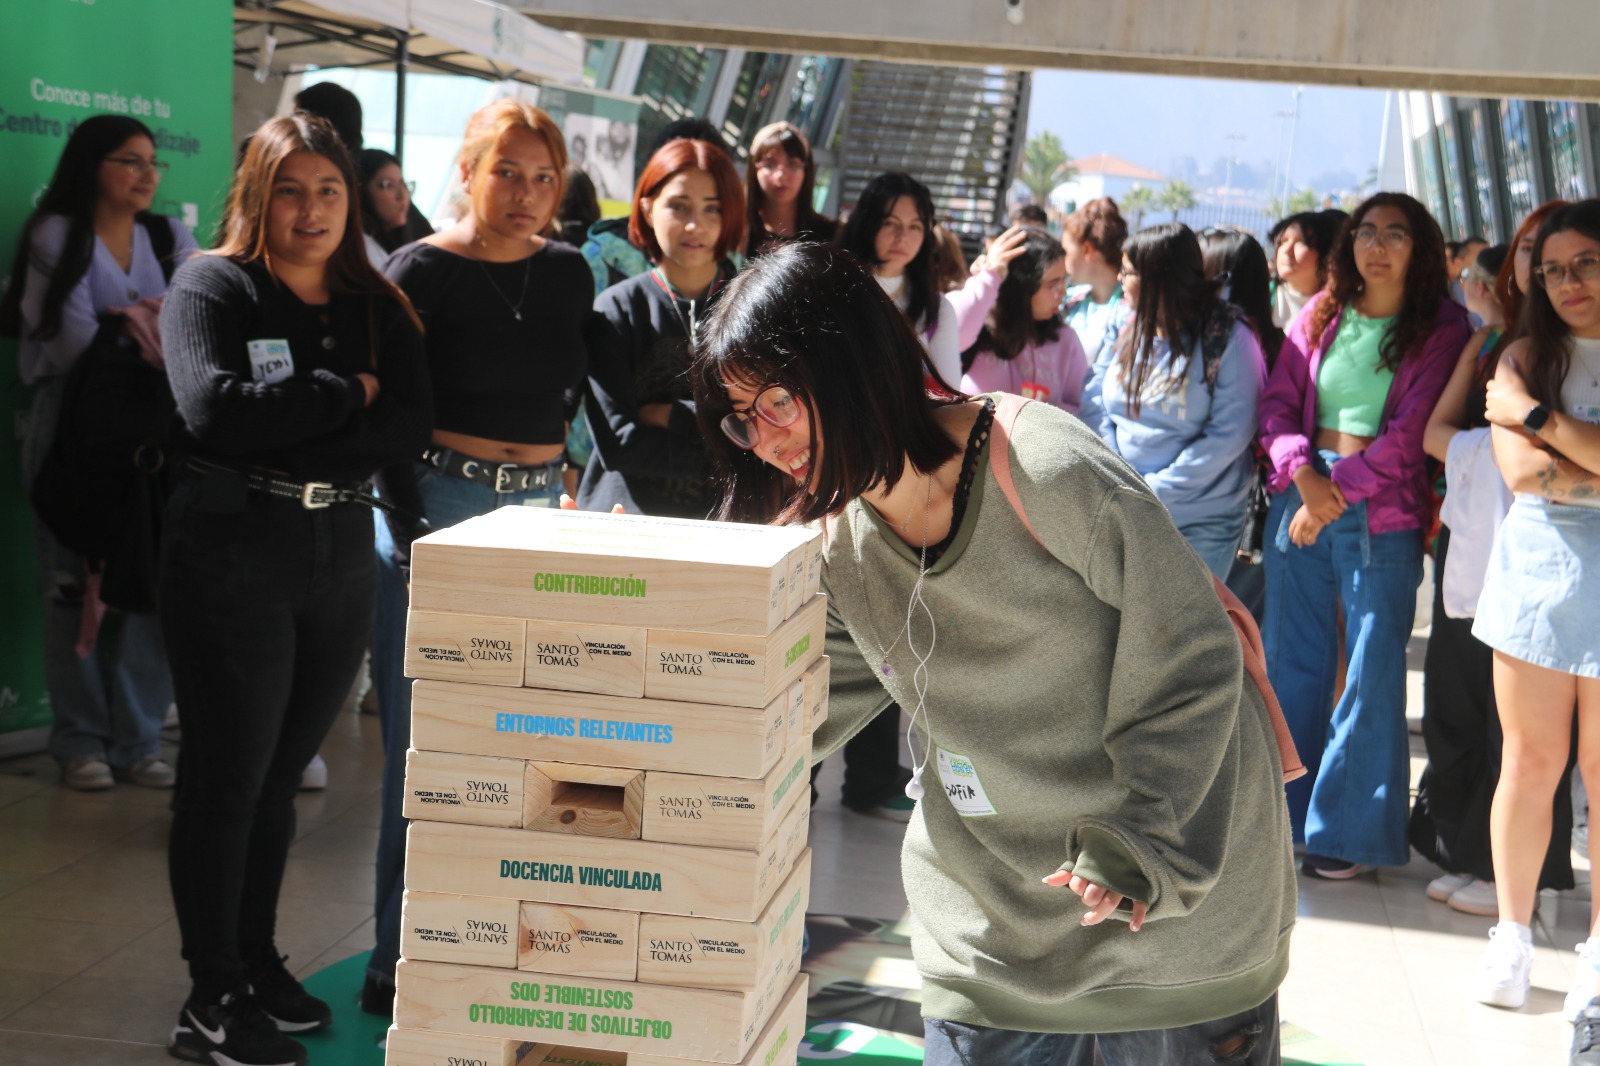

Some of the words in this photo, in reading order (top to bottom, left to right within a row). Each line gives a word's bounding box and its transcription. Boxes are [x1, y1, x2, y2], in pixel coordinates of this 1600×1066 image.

[31, 77, 91, 108] Conoce
[93, 90, 129, 113] más
[131, 93, 152, 117] de
[154, 97, 171, 119] tu
[534, 572, 646, 598] CONTRIBUCIÓN
[537, 642, 579, 656] SANTO
[585, 641, 625, 649] VINCULACIÓN
[470, 650, 513, 662] SANTO
[537, 654, 579, 667] TOMÁS
[660, 651, 702, 664] SANTO
[708, 650, 749, 659] VINCULACIÓN
[660, 662, 702, 676] TOMÁS
[735, 658, 755, 666] MEDIO
[496, 712, 575, 737] ENTORNOS
[579, 718, 673, 744] RELEVANTES
[466, 791, 509, 804] SANTO
[660, 796, 702, 808] SANTO
[707, 794, 749, 803] VINCULACIÓN
[660, 806, 702, 820] TOMÁS
[500, 859, 573, 884] DOCENCIA
[579, 866, 662, 892] VINCULADA
[466, 931, 508, 945] SANTO
[528, 929, 571, 943] SANTO
[576, 929, 617, 938] VINCULACIÓN
[528, 940, 570, 954] TOMÁS
[650, 939, 692, 952] SANTO
[698, 938, 739, 947] VINCULACIÓN
[650, 951, 692, 964] TOMÁS
[510, 981, 540, 1002] ODS
[544, 984, 633, 1010] SOSTENIBLE
[469, 1003, 564, 1029] DESARROLLO
[568, 1012, 587, 1031] DE
[591, 1014, 672, 1039] OBJETIVOS
